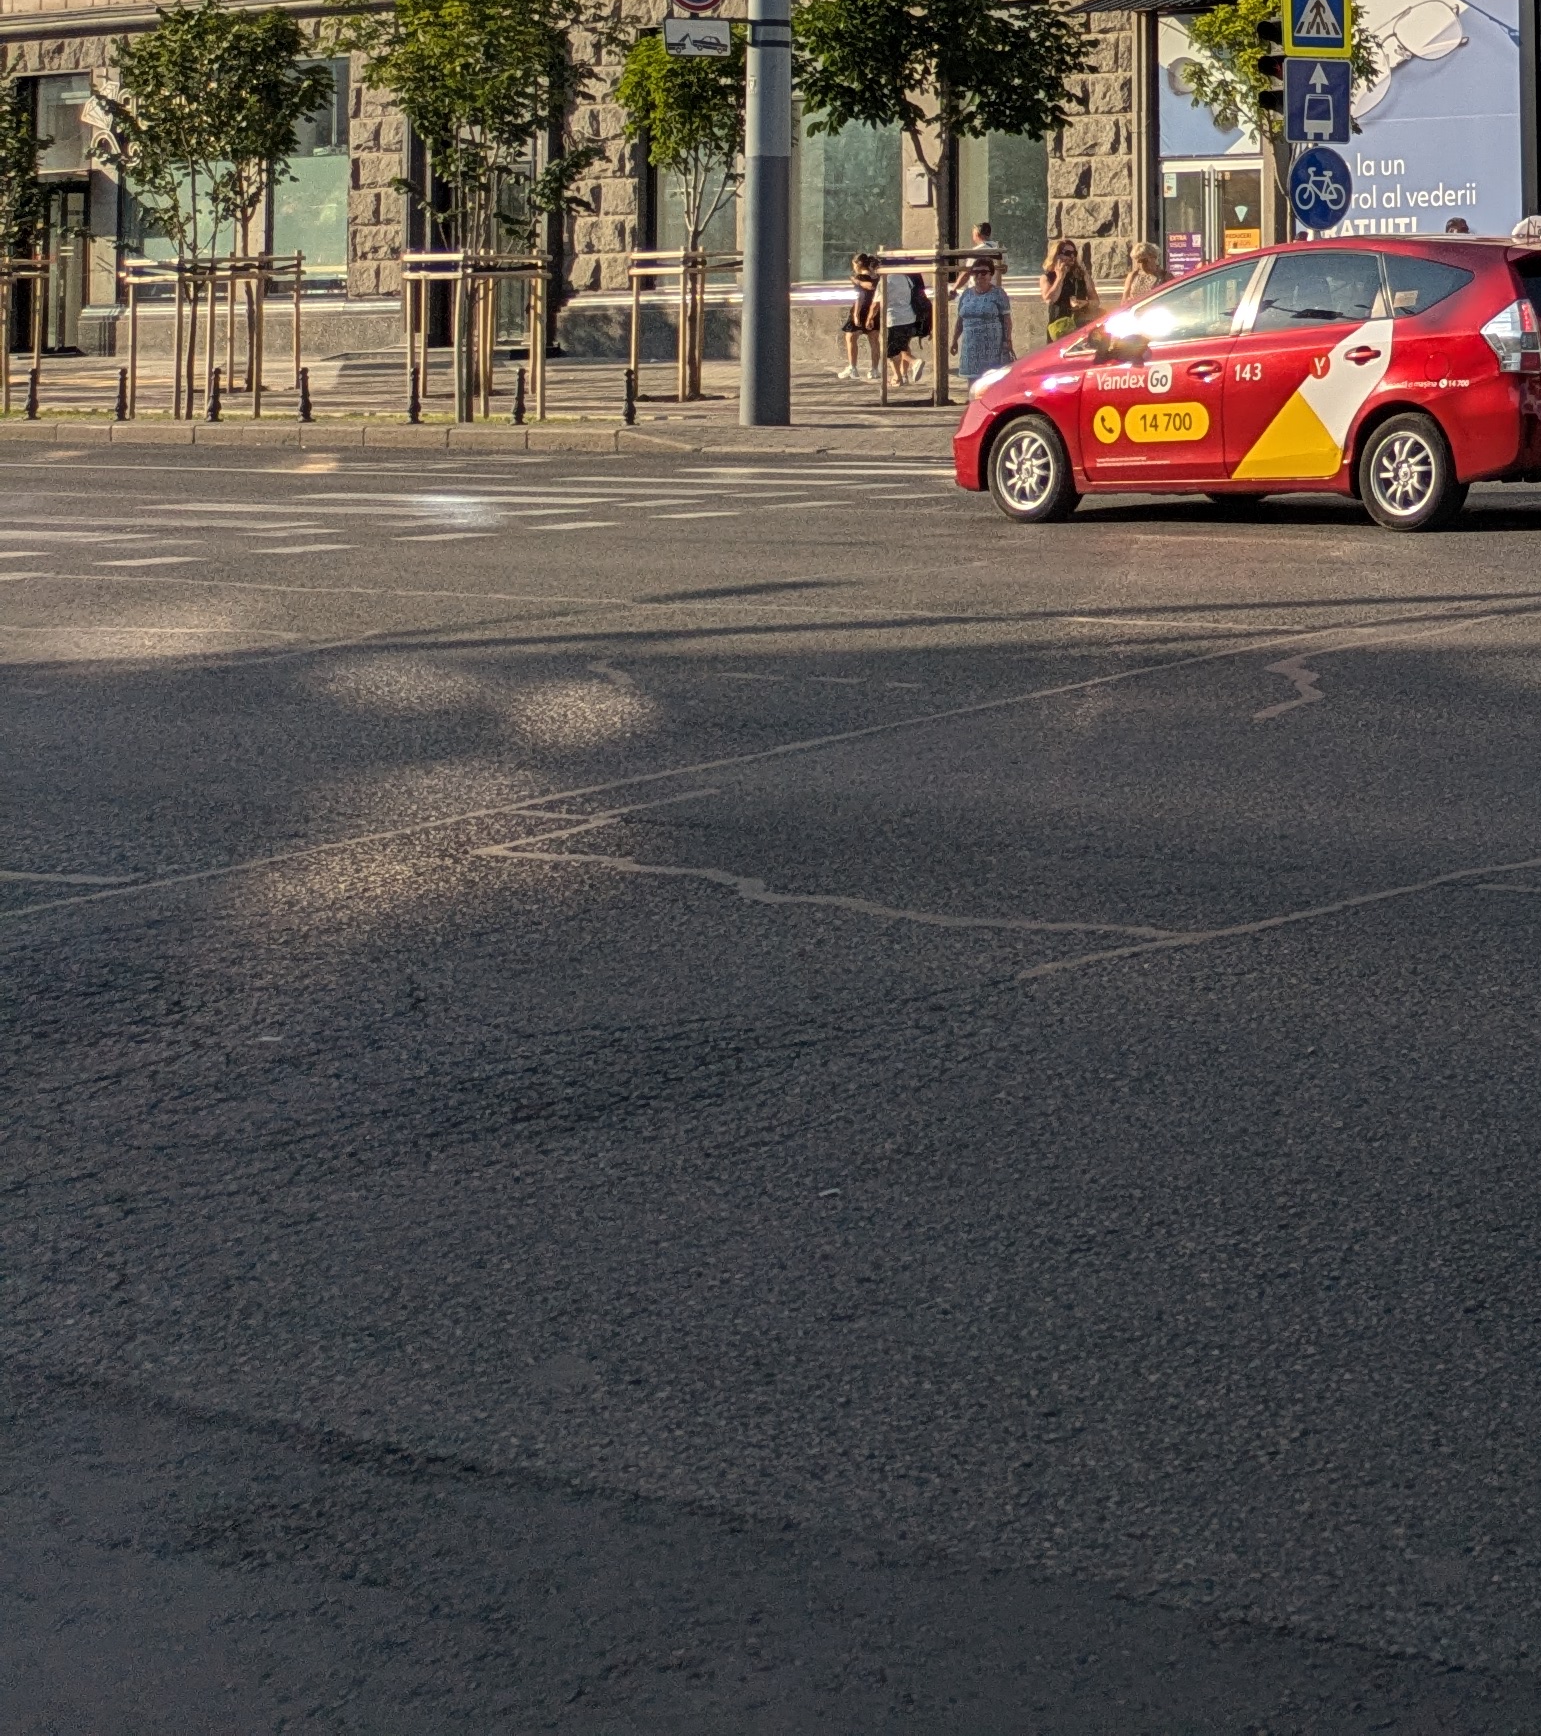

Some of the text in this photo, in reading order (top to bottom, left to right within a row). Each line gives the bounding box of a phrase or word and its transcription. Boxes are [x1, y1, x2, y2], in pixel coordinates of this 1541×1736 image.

[1357, 153, 1405, 176] la un
[1351, 182, 1476, 209] rol al vederii
[1096, 373, 1145, 391] Yandex
[1150, 370, 1168, 387] Go
[1234, 363, 1262, 382] 143
[1140, 412, 1193, 432] 14 700
